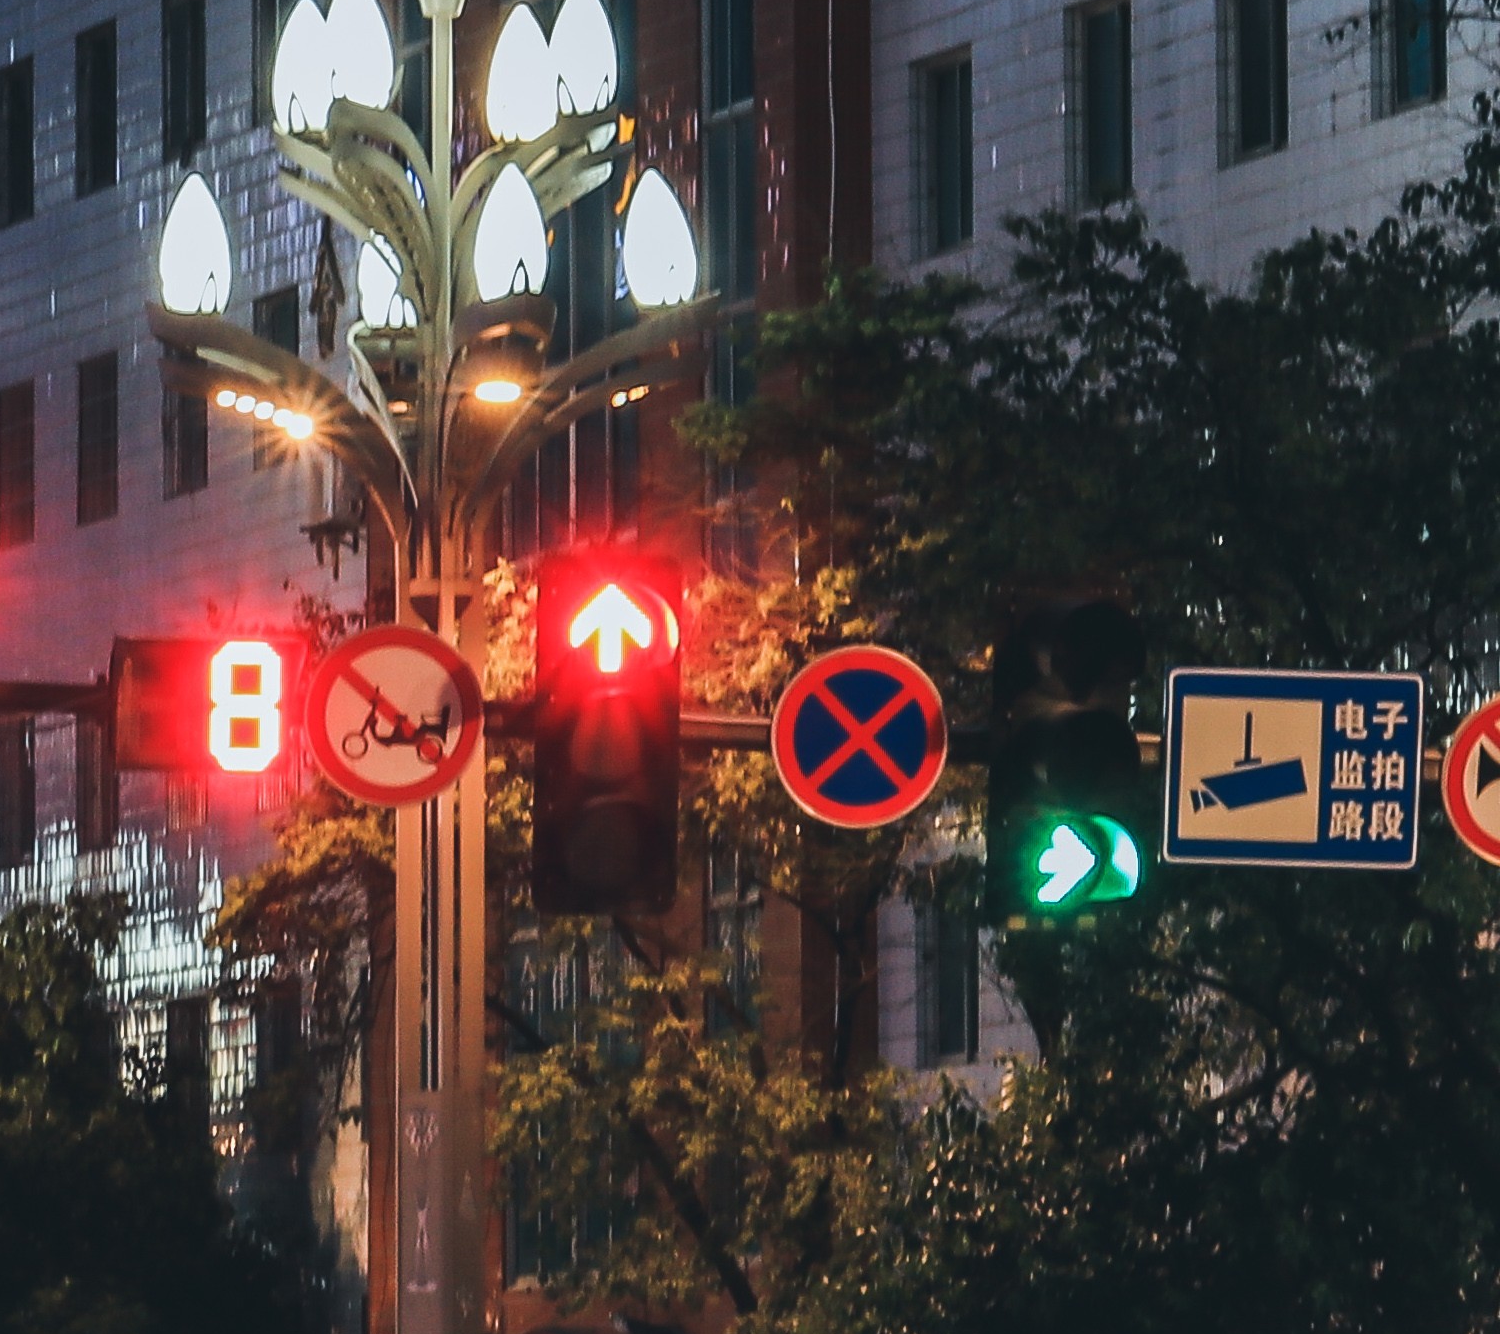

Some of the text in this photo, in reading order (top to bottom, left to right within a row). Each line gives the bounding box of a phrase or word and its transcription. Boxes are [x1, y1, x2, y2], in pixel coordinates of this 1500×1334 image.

[210, 641, 282, 772] 8
[1334, 699, 1408, 740] 电子
[1330, 749, 1406, 790] 监拍
[1328, 801, 1405, 841] 路段
